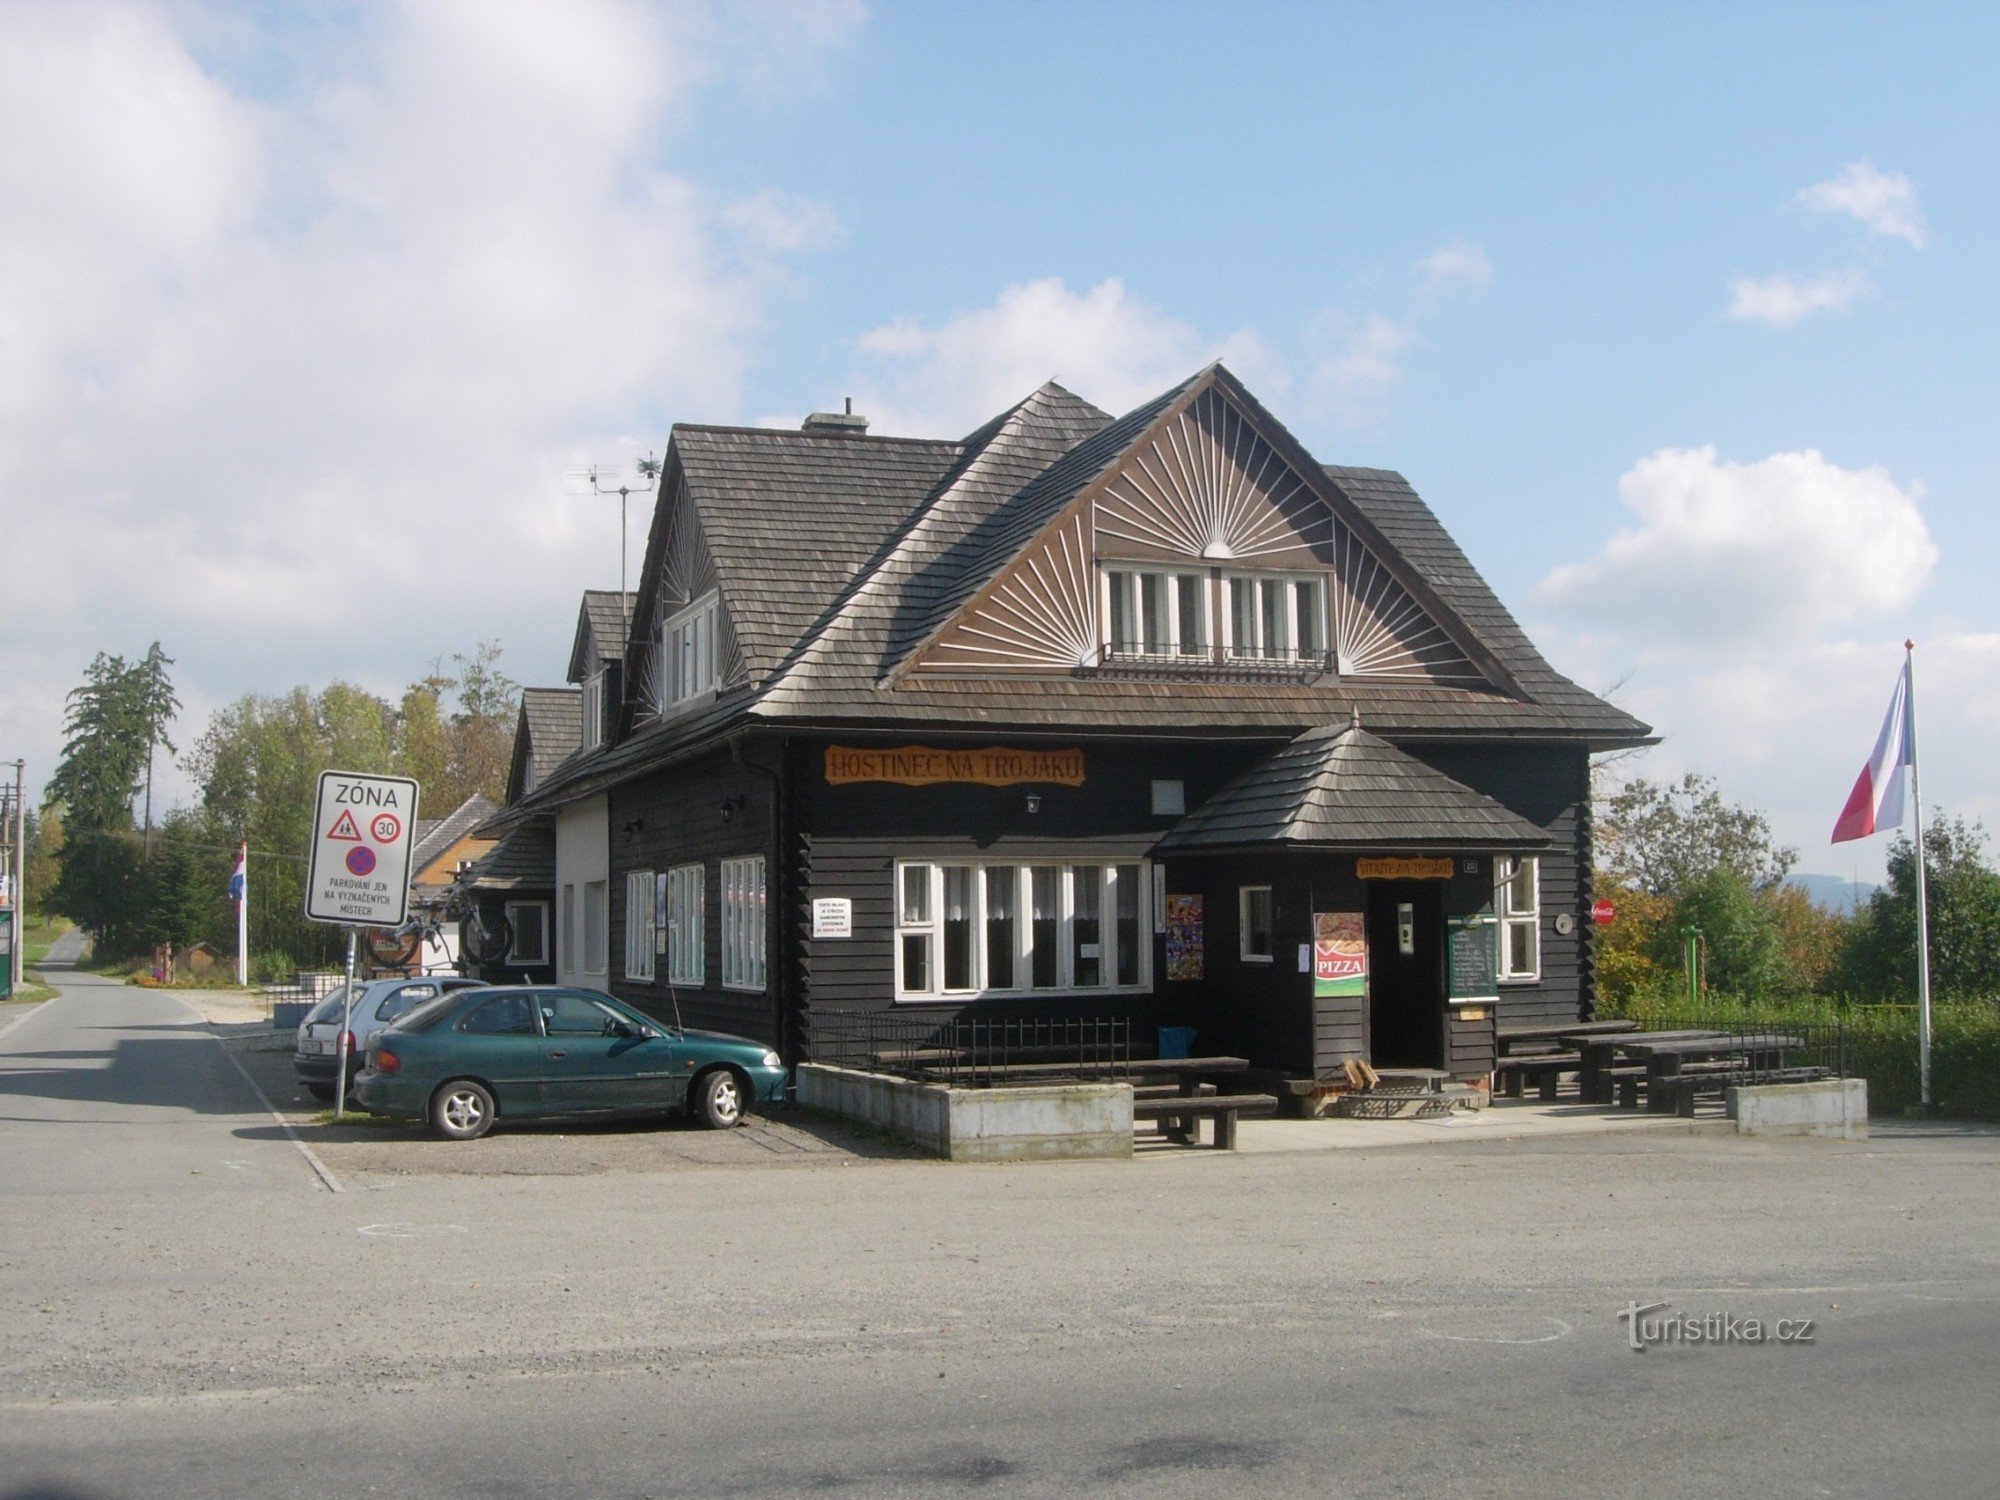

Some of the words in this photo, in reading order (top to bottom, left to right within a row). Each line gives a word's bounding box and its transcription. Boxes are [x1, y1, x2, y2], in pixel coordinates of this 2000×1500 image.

[831, 753, 939, 777] HOSTINEC
[946, 754, 974, 778] NA
[335, 781, 398, 808] ZÓNA
[377, 822, 394, 835] 30
[329, 877, 371, 889] PARKOVÁNÍ
[374, 882, 387, 891] JEN
[324, 890, 335, 899] NA
[338, 891, 391, 904] VYZNAČENÝCH
[340, 903, 372, 915] MÍSTECH
[1318, 960, 1362, 973] PIZZA
